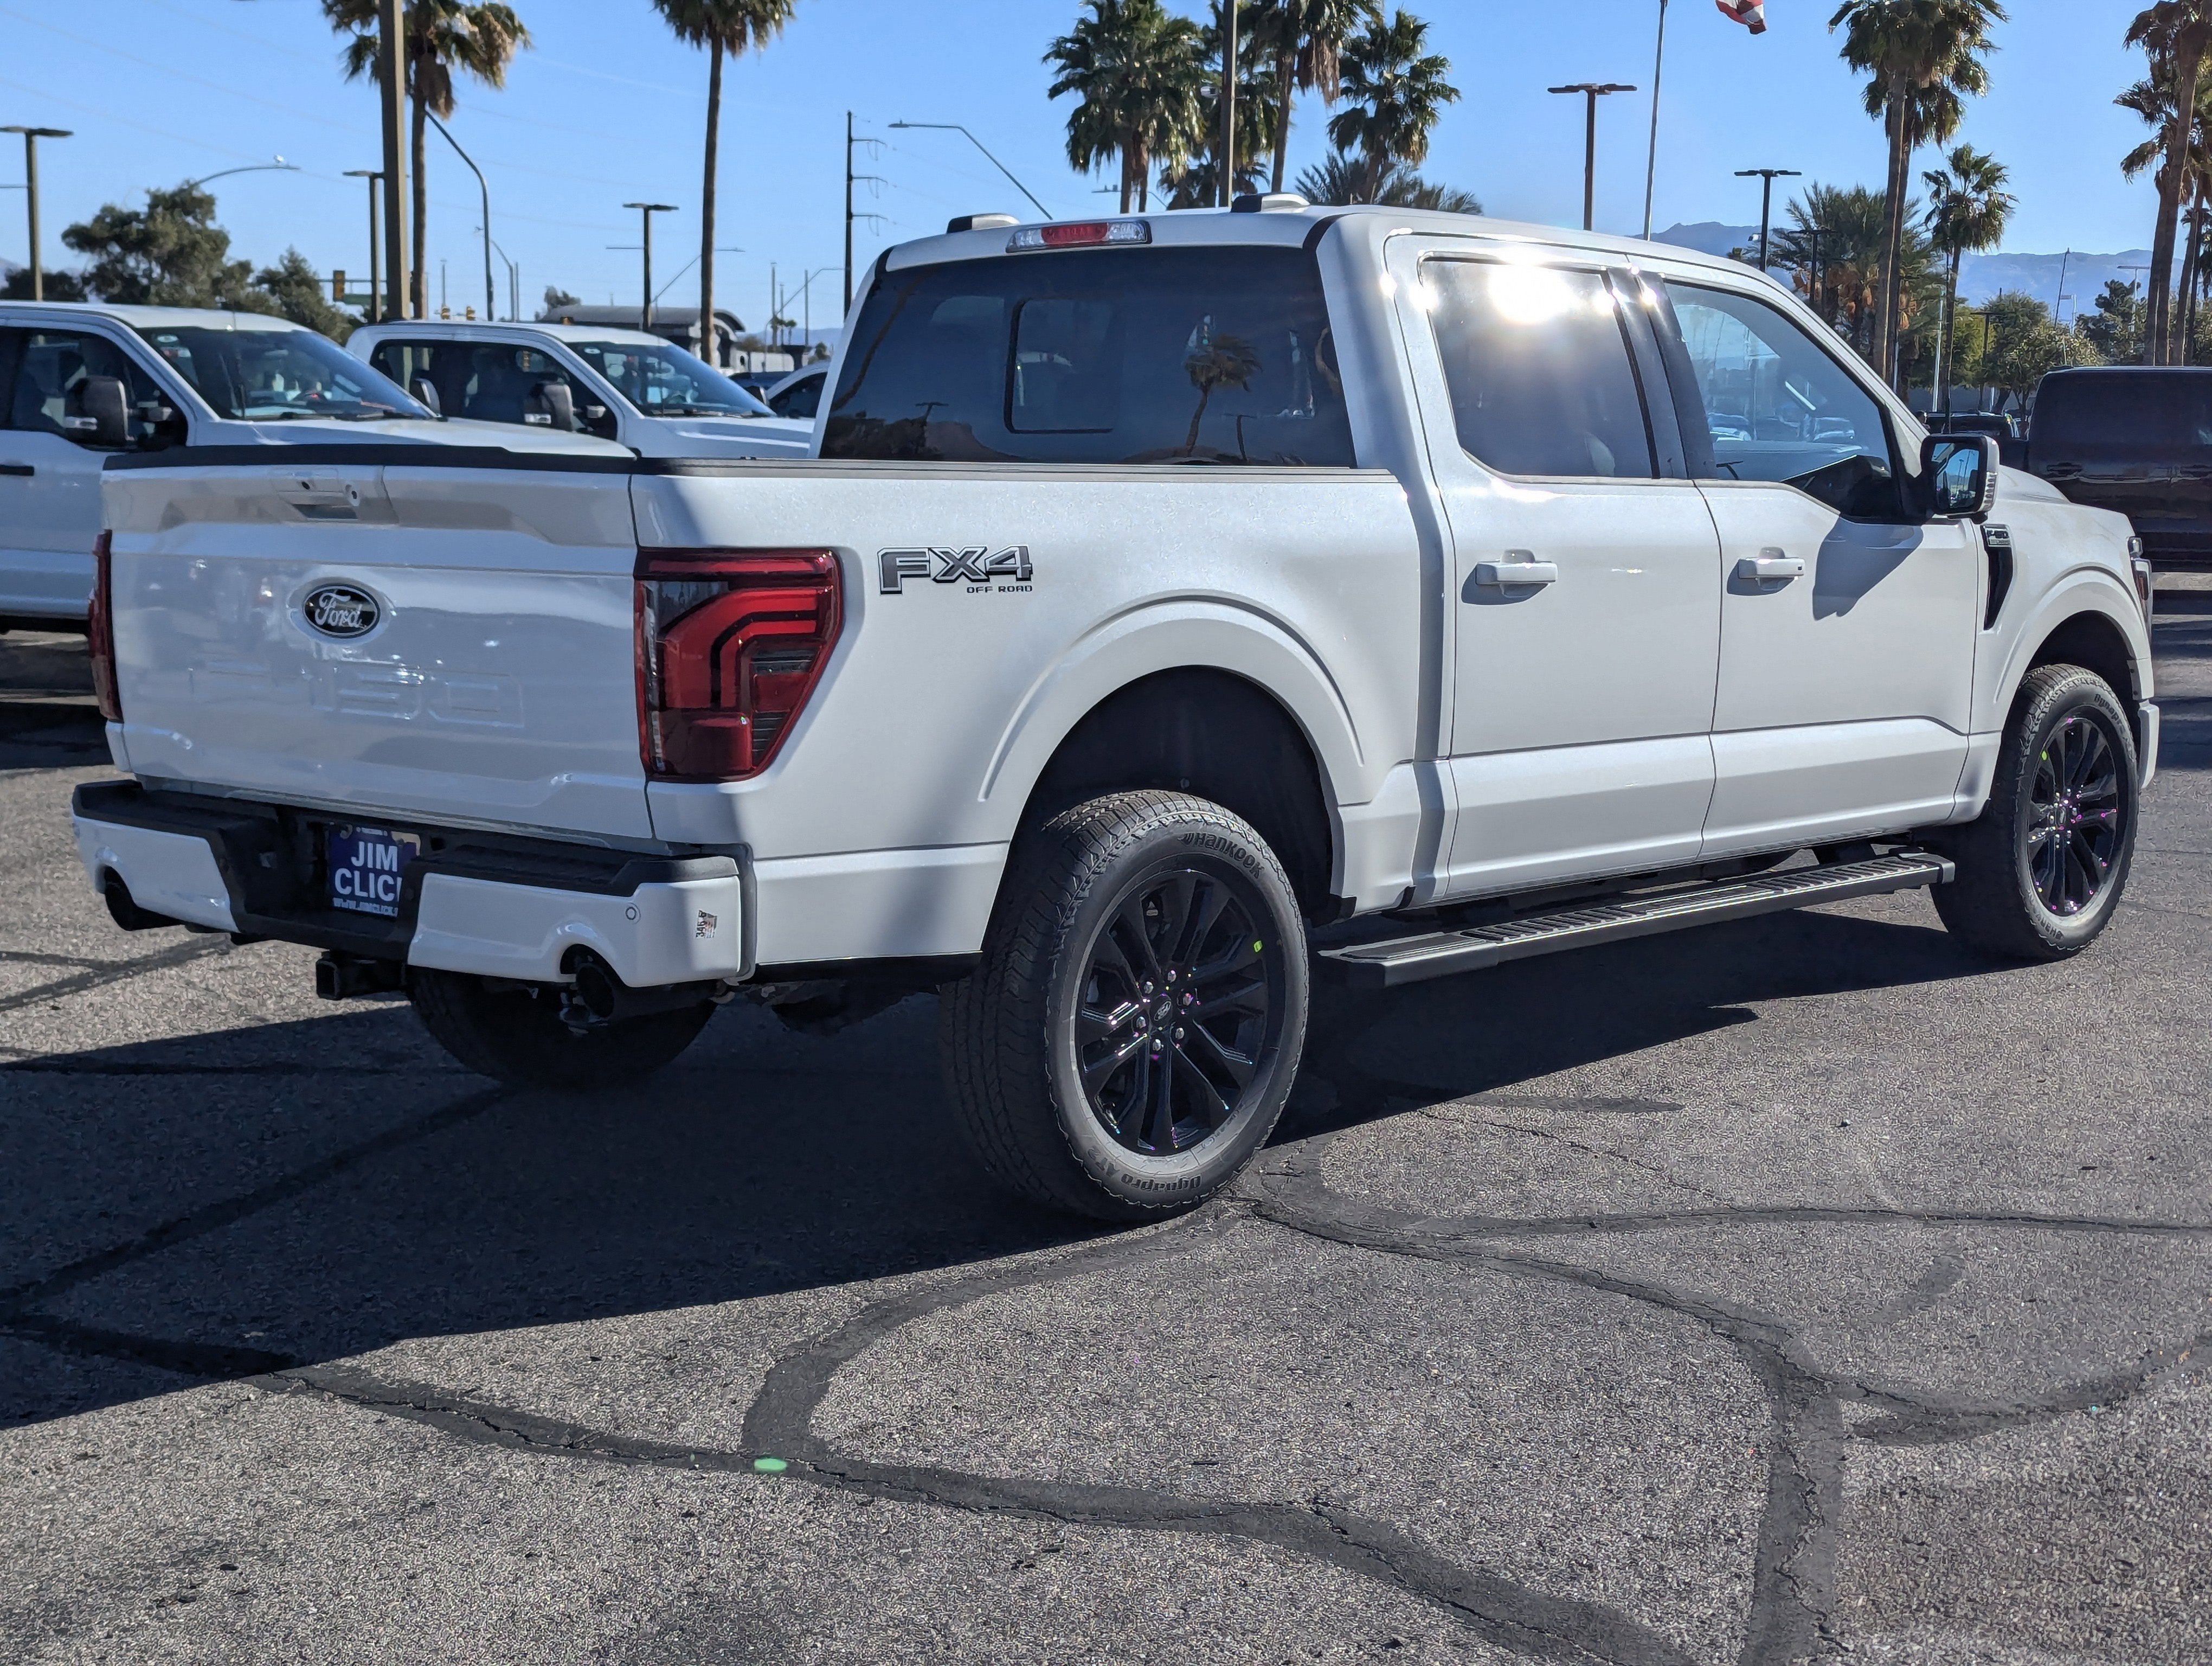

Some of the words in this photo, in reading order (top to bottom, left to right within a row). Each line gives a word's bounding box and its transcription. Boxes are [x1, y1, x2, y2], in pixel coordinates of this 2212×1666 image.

[877, 545, 1033, 595] FX4
[315, 592, 366, 630] Ford
[350, 841, 398, 873] JIM
[1120, 1174, 1202, 1193] Dynapro
